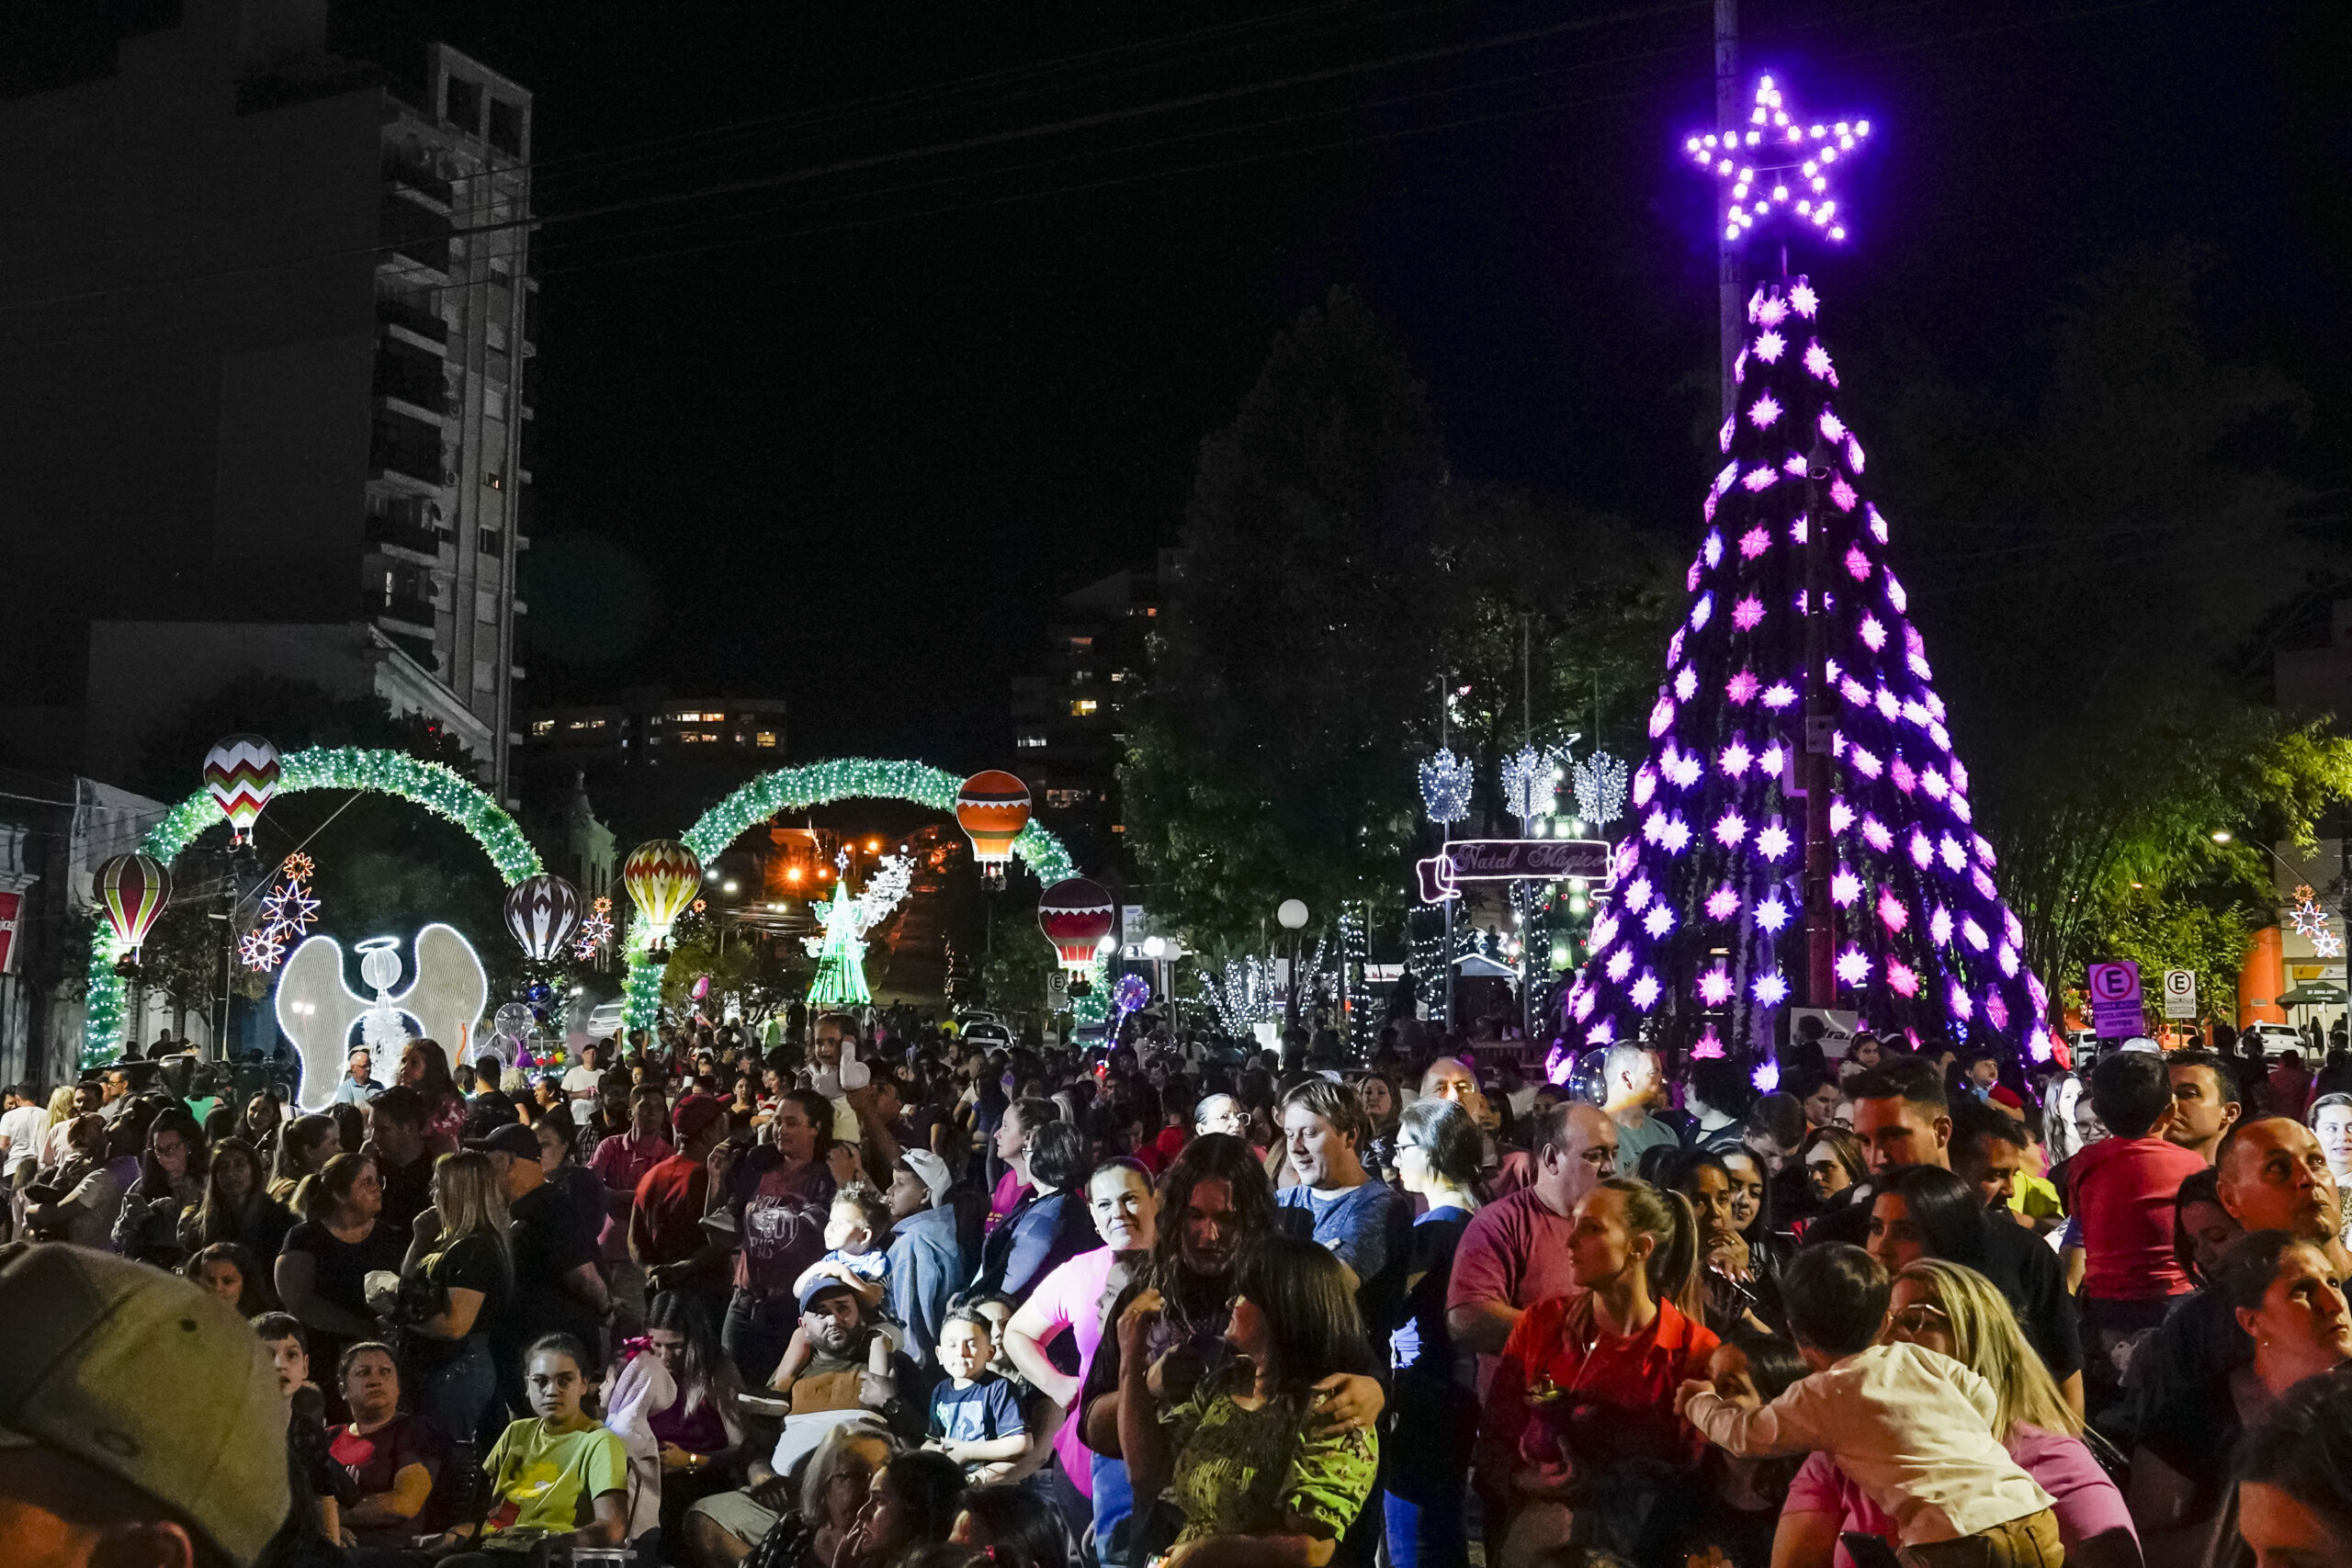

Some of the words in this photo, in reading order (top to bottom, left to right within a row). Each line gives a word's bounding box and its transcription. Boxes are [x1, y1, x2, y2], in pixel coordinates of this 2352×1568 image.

[1453, 843, 1520, 872] Natal
[1055, 976, 1061, 987] E
[2107, 970, 2124, 993] E
[2175, 976, 2185, 989] E
[2095, 1010, 2141, 1020] EXCLUSIVO
